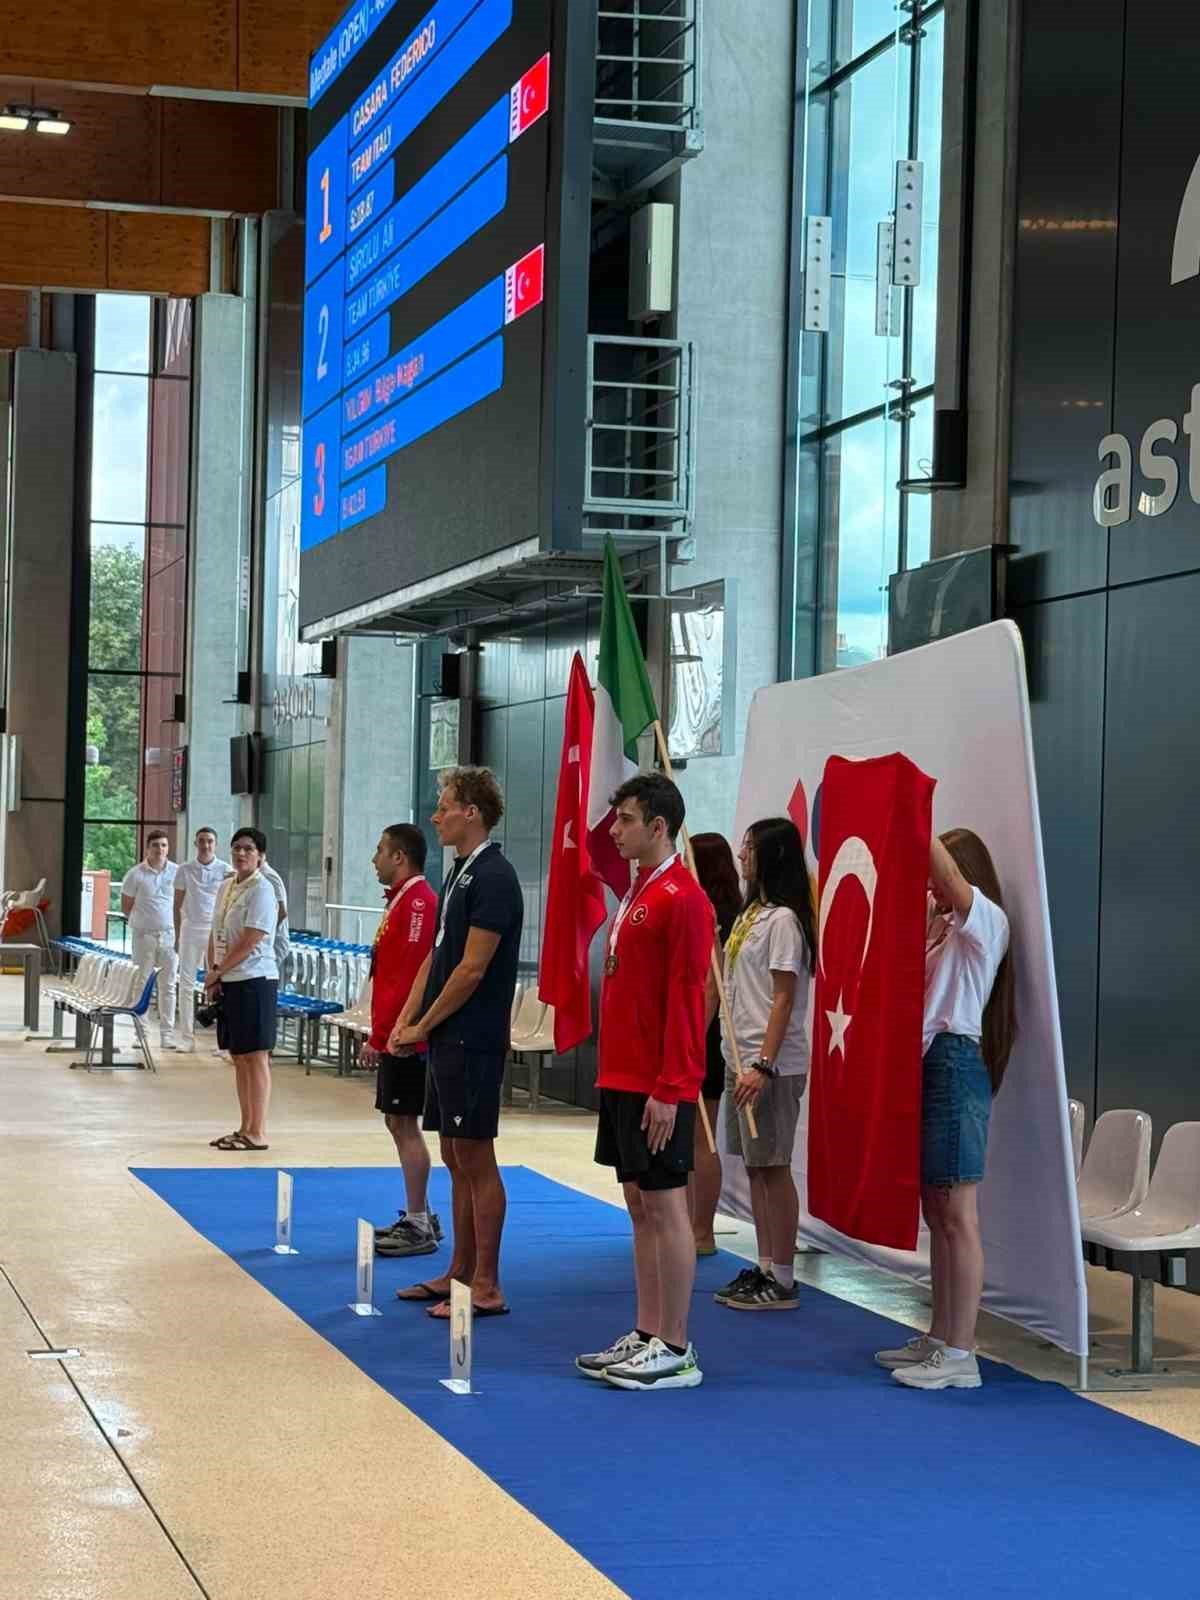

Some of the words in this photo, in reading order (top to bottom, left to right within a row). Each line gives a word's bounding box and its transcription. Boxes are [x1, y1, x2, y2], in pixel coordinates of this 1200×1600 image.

[353, 79, 388, 137] CASARA
[391, 19, 436, 94] FEDERICO
[320, 167, 332, 245] 1
[317, 303, 329, 380] 2
[314, 442, 325, 517] 3
